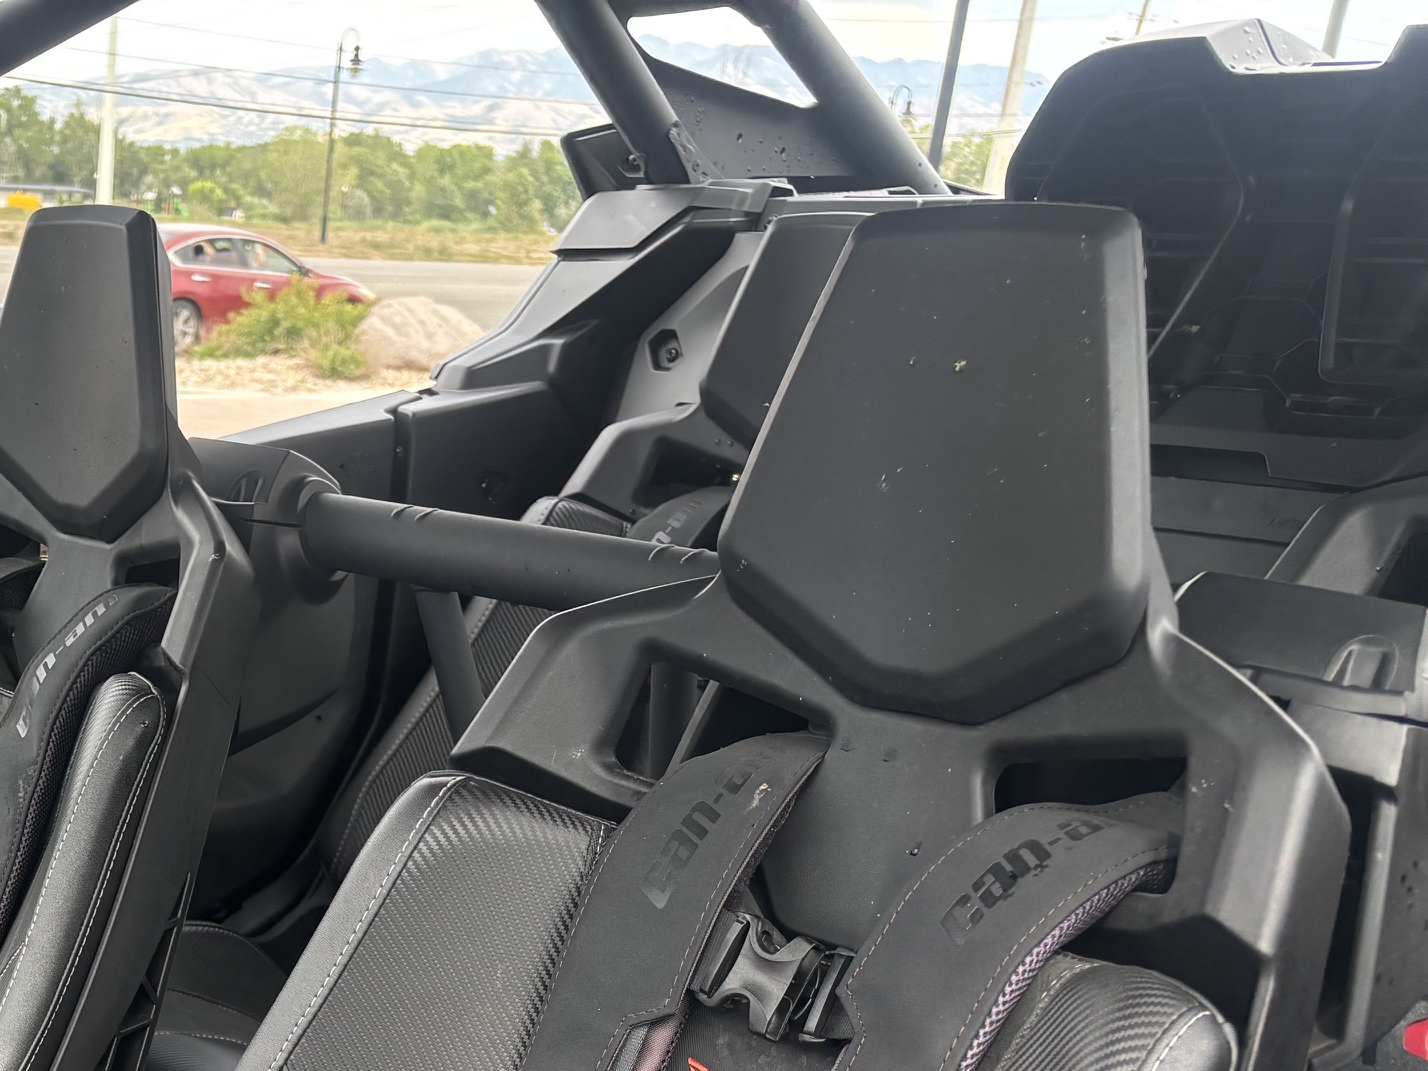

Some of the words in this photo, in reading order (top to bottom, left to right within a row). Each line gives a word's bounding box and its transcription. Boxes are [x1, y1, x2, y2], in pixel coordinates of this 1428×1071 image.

[16, 594, 119, 738] cn-am
[639, 760, 764, 909] can-a
[940, 818, 1110, 946] can-a
